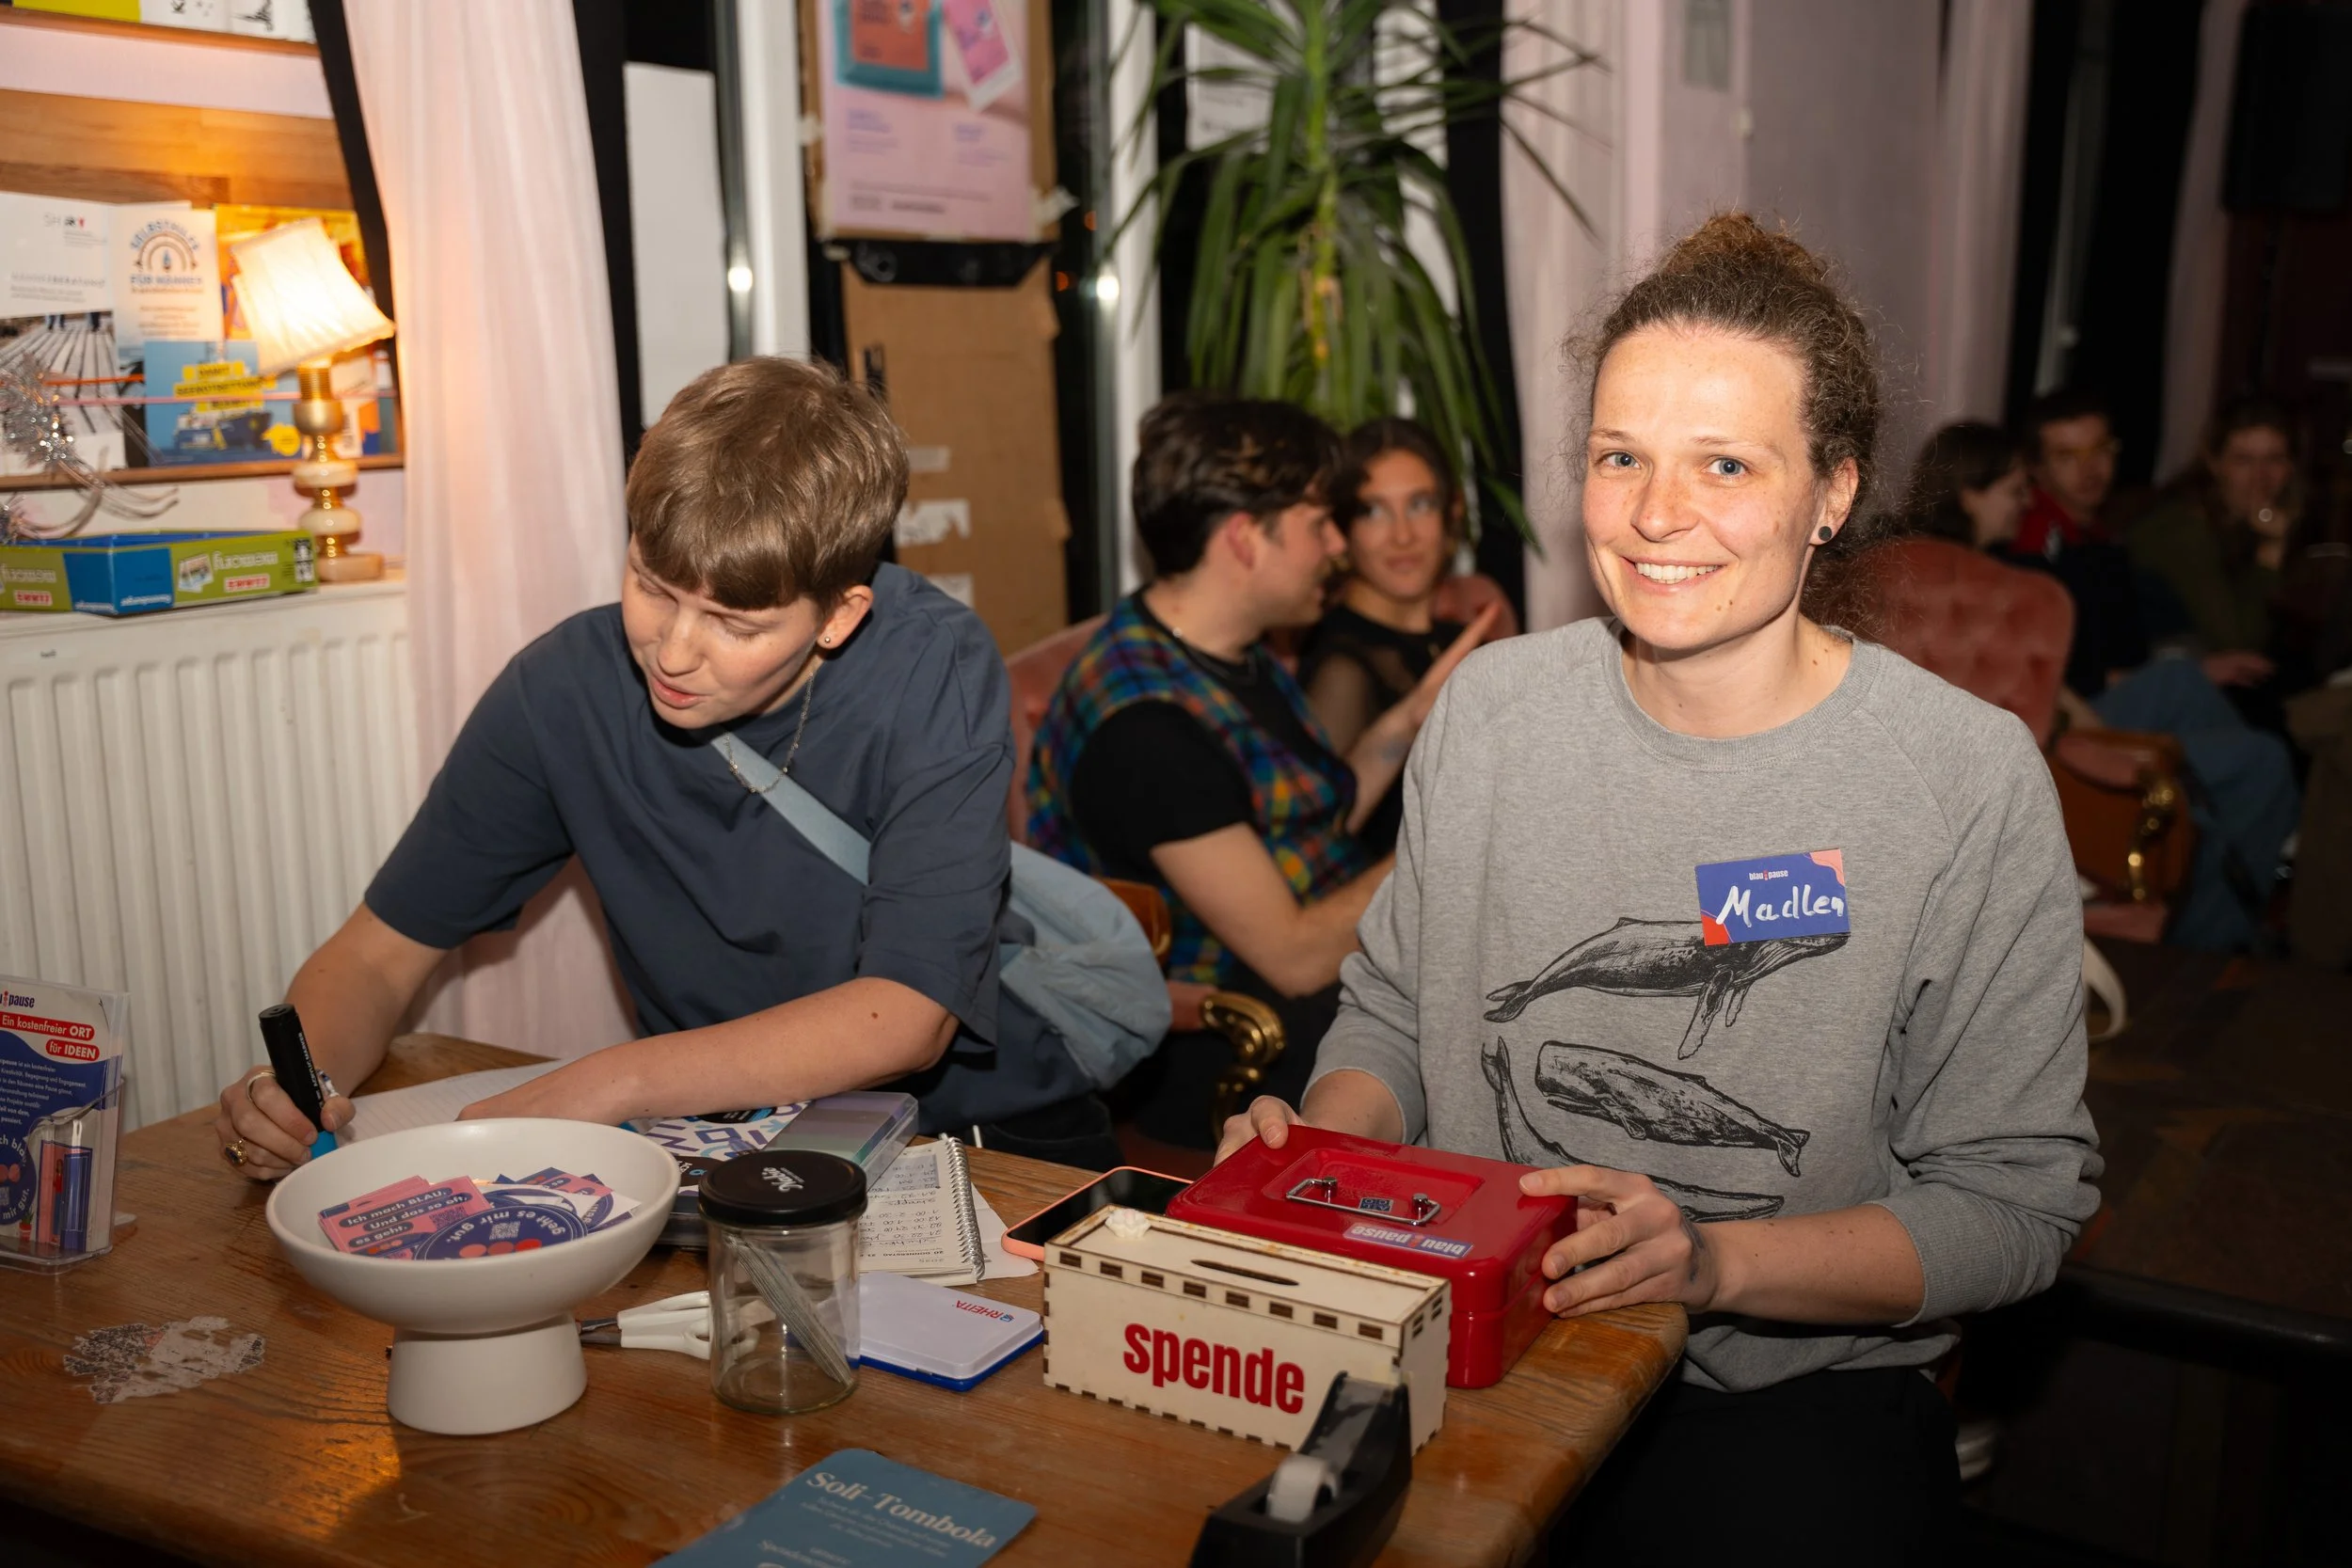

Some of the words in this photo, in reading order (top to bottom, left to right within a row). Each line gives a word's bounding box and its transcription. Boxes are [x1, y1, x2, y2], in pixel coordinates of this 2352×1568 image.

[213, 551, 278, 571] memory
[1716, 884, 1844, 927] Madlen
[2, 1015, 14, 1026] Ein
[17, 1017, 67, 1036] kostenfreier
[69, 1025, 92, 1038] ORT
[49, 1040, 62, 1053] für
[64, 1044, 96, 1059] IDEEN
[3, 1207, 17, 1219] mir
[18, 1188, 30, 1211] gut.
[347, 1214, 367, 1226] Ich
[371, 1202, 405, 1218] mach
[408, 1190, 447, 1206] BLAU.
[370, 1219, 397, 1230] Und
[402, 1210, 424, 1220] das
[428, 1202, 442, 1212] so
[446, 1196, 468, 1206] oft,
[480, 1211, 510, 1225] mir
[536, 1214, 566, 1236] geht
[356, 1237, 370, 1245] es
[374, 1225, 407, 1238] geht.
[446, 1223, 475, 1243] gut.
[956, 1300, 1004, 1319] RHEITA
[1123, 1323, 1304, 1414] spende
